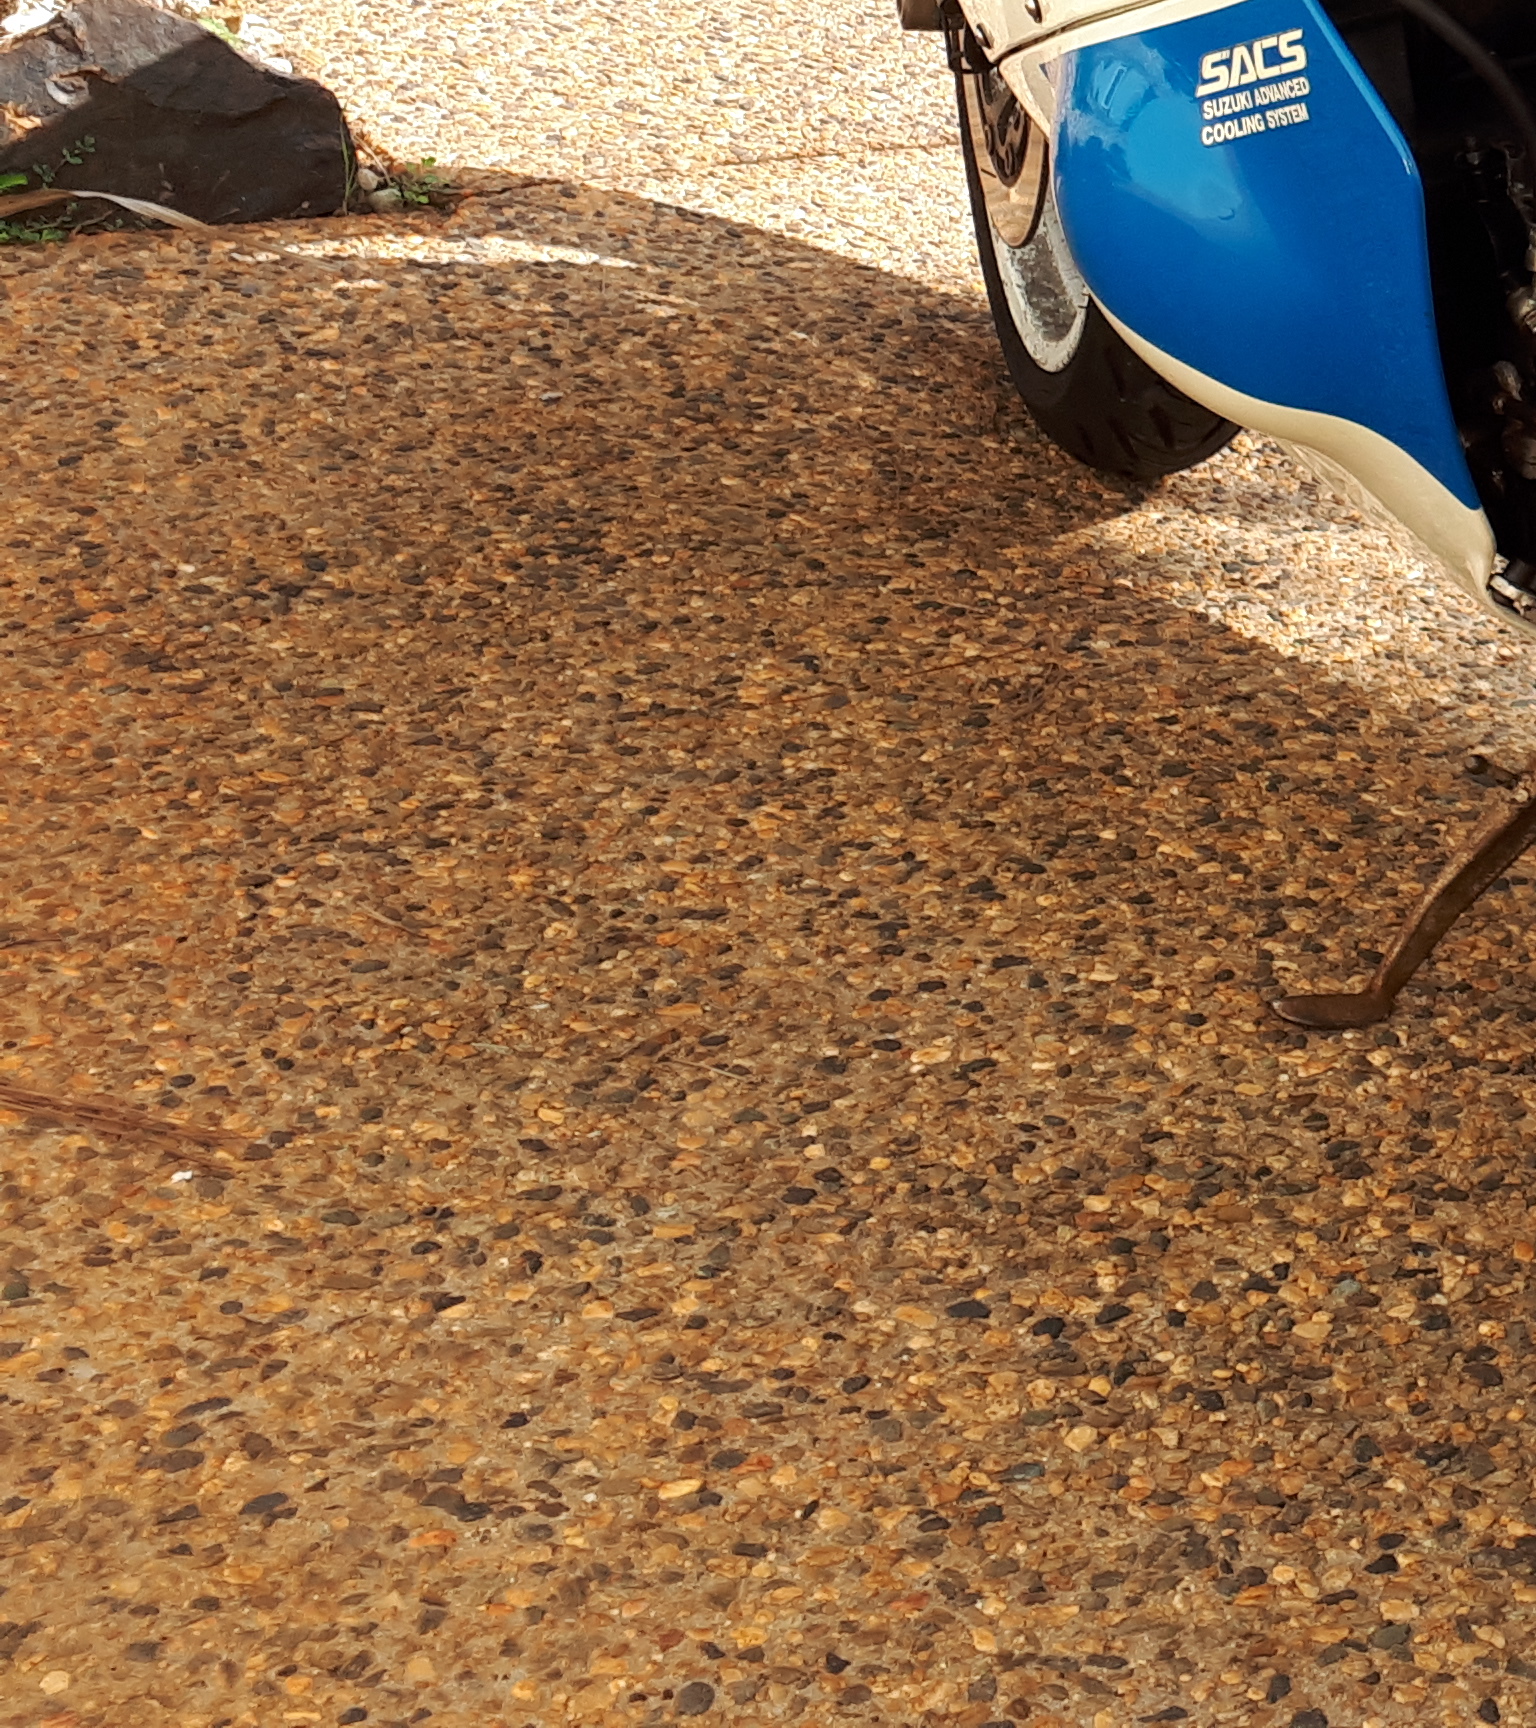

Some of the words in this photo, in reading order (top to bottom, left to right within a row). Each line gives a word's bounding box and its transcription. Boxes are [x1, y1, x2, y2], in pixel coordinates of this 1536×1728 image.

[1195, 28, 1308, 98] SACS
[1202, 90, 1254, 121] SUZUKI
[1254, 75, 1311, 107] ADVANCED
[1201, 113, 1266, 147] COOLING
[1265, 102, 1310, 130] SYSTEM
